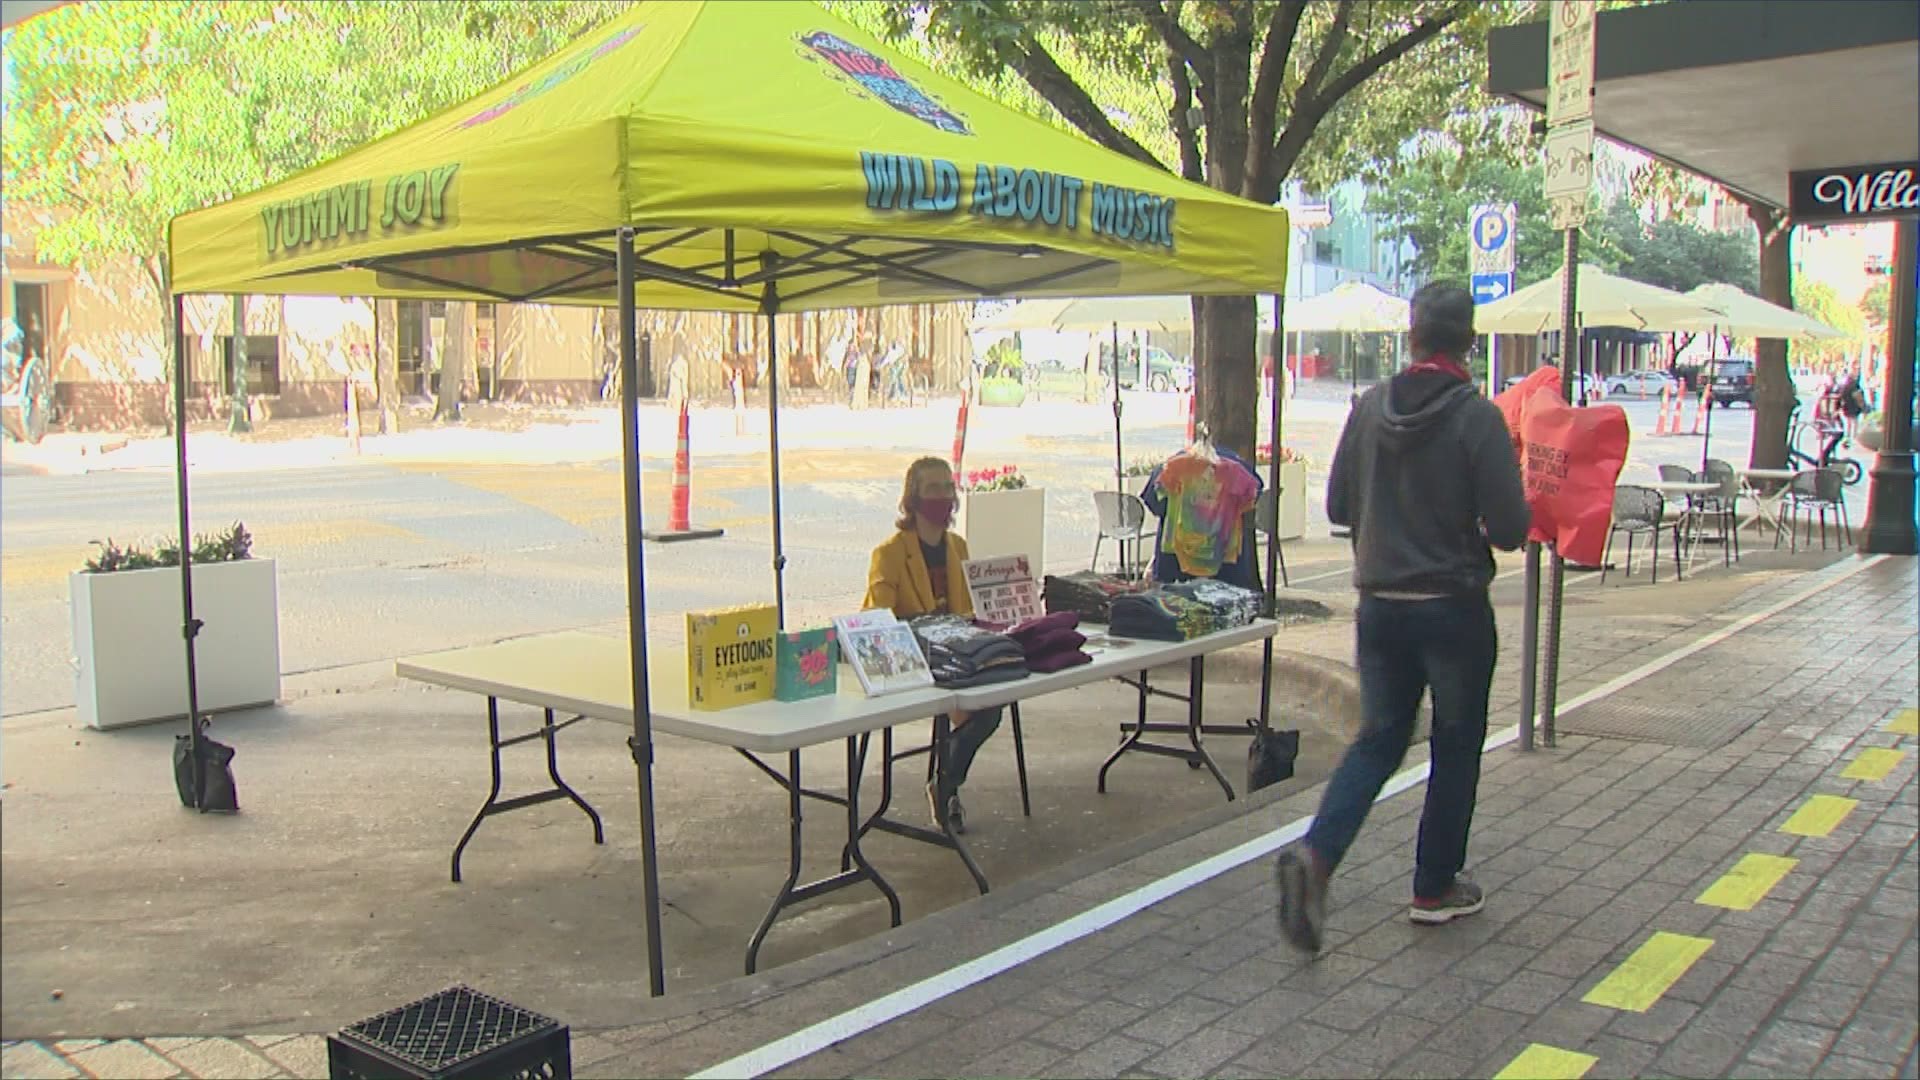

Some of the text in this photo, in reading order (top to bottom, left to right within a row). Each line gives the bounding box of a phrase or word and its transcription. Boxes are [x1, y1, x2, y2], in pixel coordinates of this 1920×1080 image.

[261, 163, 460, 253] YUMMI JOY
[859, 151, 1176, 248] WILD ABOUT MUSIC
[1482, 216, 1503, 248] P
[715, 637, 773, 668] EYETOONS
